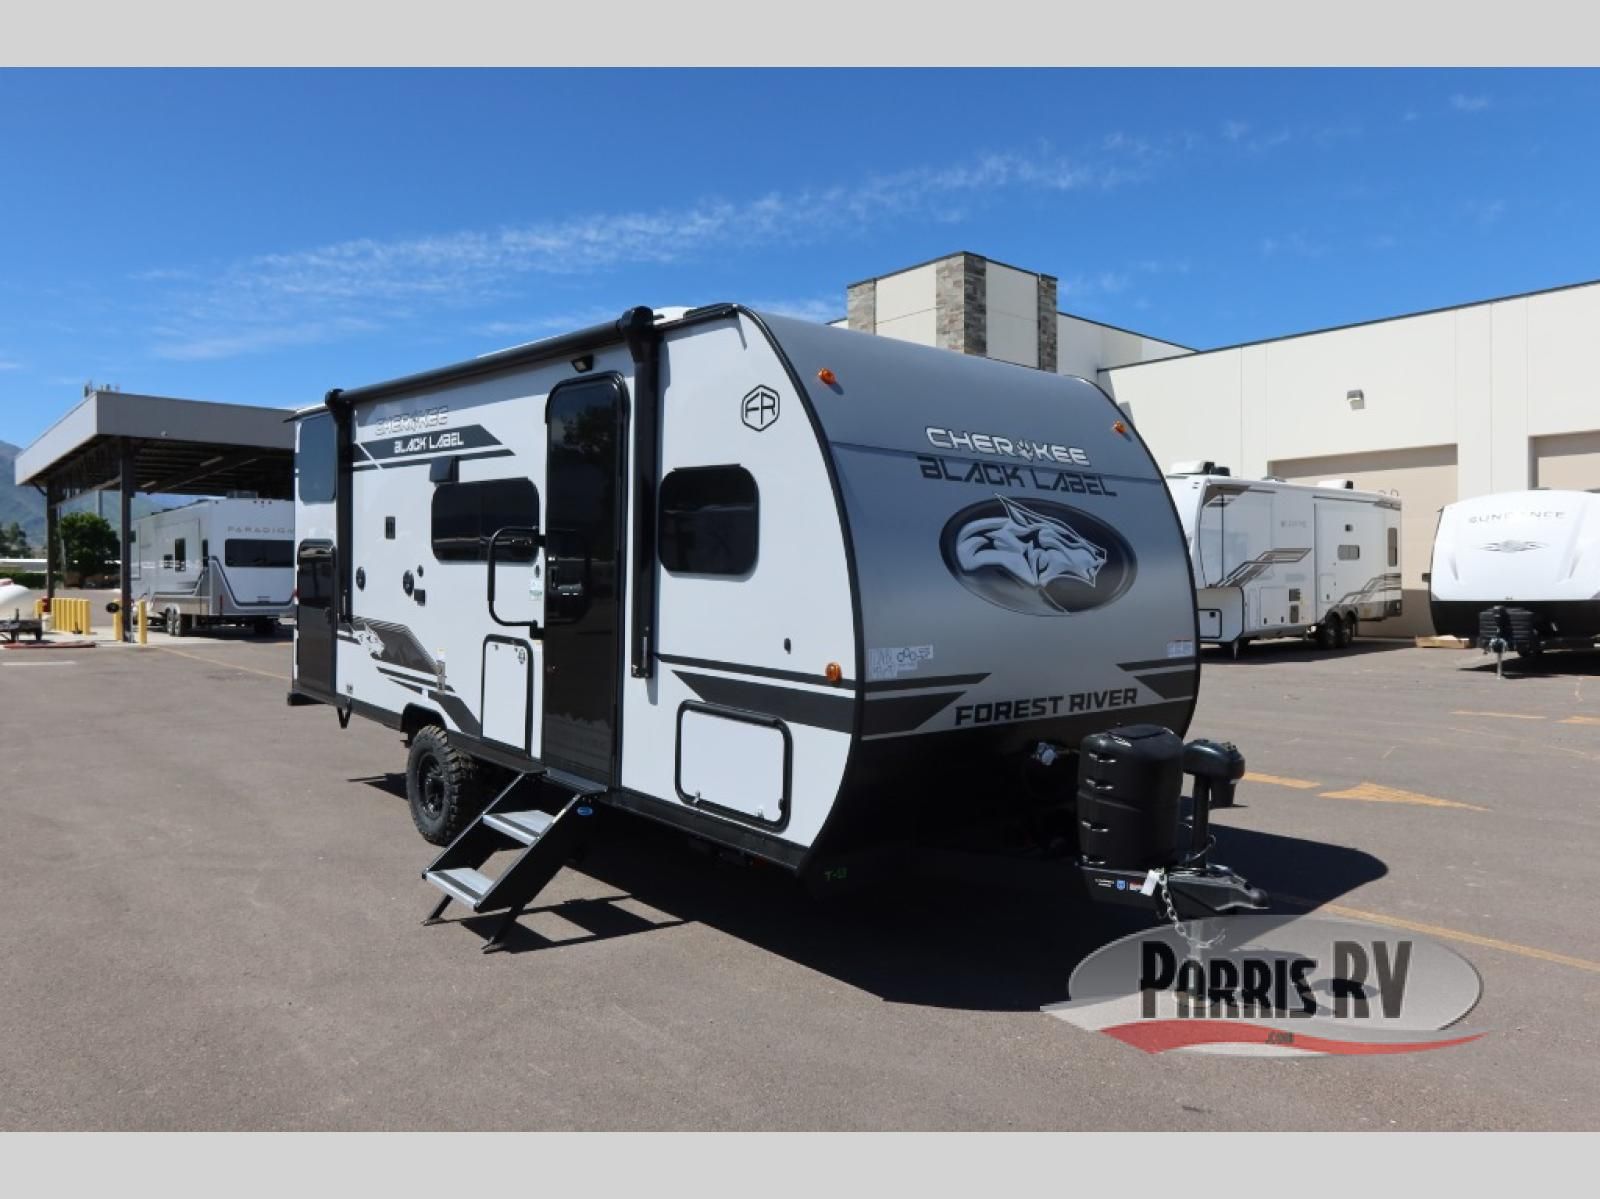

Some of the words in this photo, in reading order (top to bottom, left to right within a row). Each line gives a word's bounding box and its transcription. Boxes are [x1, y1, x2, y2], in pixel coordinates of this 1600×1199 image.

[394, 436, 427, 454] BLACK
[429, 432, 464, 449] LABEL
[925, 426, 1091, 467] CHEROKEE
[917, 456, 1025, 488] BLACK
[1030, 468, 1117, 496] LABEL
[1468, 511, 1566, 524] SUNDNCE
[955, 696, 1064, 726] FOREST
[1069, 688, 1138, 712] RIVER
